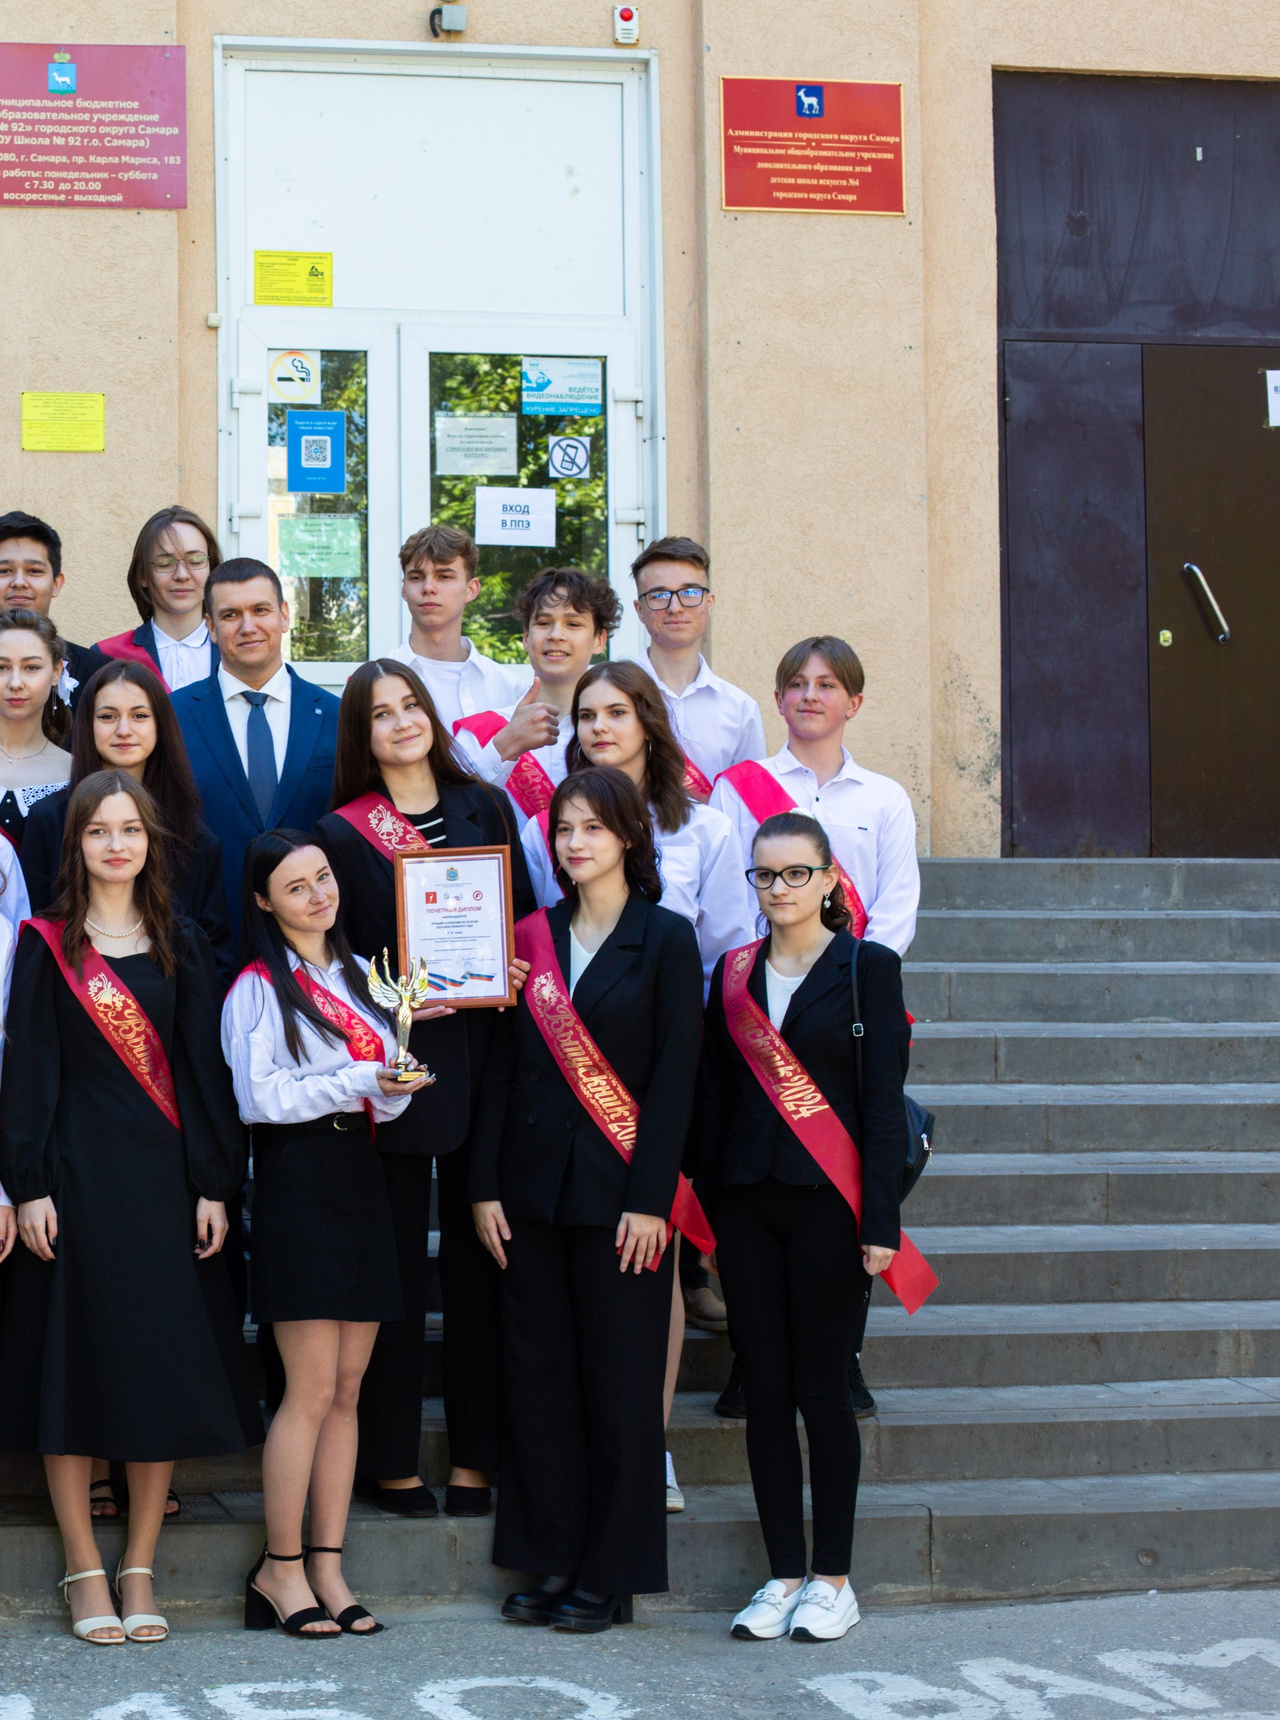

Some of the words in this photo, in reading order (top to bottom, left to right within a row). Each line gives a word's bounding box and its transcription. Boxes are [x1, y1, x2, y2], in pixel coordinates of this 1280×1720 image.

[76, 99, 139, 110] бюджетное
[92, 112, 159, 122] учреждение
[11, 123, 33, 132] 92»
[35, 125, 97, 135] городского
[99, 126, 135, 135] округа
[138, 125, 178, 135] Самара
[728, 129, 793, 138] Администрация
[795, 132, 838, 140] городского
[840, 134, 867, 142] округа
[869, 134, 900, 143] Самара
[14, 135, 50, 145] Школа
[53, 136, 65, 146] №
[68, 137, 81, 146] 92
[84, 138, 102, 146] г.о.
[104, 137, 150, 149] Самара)
[733, 145, 786, 155] Муниципальное
[787, 148, 856, 158] общеобразовательное
[857, 150, 894, 159] учреждение
[30, 154, 70, 164] Самара,
[72, 156, 87, 165] пр.
[89, 155, 119, 164] Карла
[121, 155, 160, 165] Маркса,
[163, 156, 181, 165] 183
[757, 162, 812, 170] дополнительного
[813, 163, 852, 173] образования
[854, 165, 872, 173] детей
[3, 168, 42, 179] работы:
[44, 170, 109, 179] понедельник
[118, 171, 158, 180] суббота
[33, 181, 54, 189] 7.30
[59, 182, 71, 191] до
[73, 181, 101, 190] 20.00
[819, 178, 847, 187] искусств
[3, 192, 65, 201] воскресенье
[74, 192, 123, 202] выходной
[773, 191, 808, 200] городского
[809, 192, 831, 201] округа
[832, 191, 857, 201] Самара
[502, 504, 530, 514] ВХОД
[501, 520, 507, 528] В
[510, 520, 530, 529] ППЭ
[544, 1003, 629, 1120] Выпускник
[773, 1074, 830, 1122] 2024
